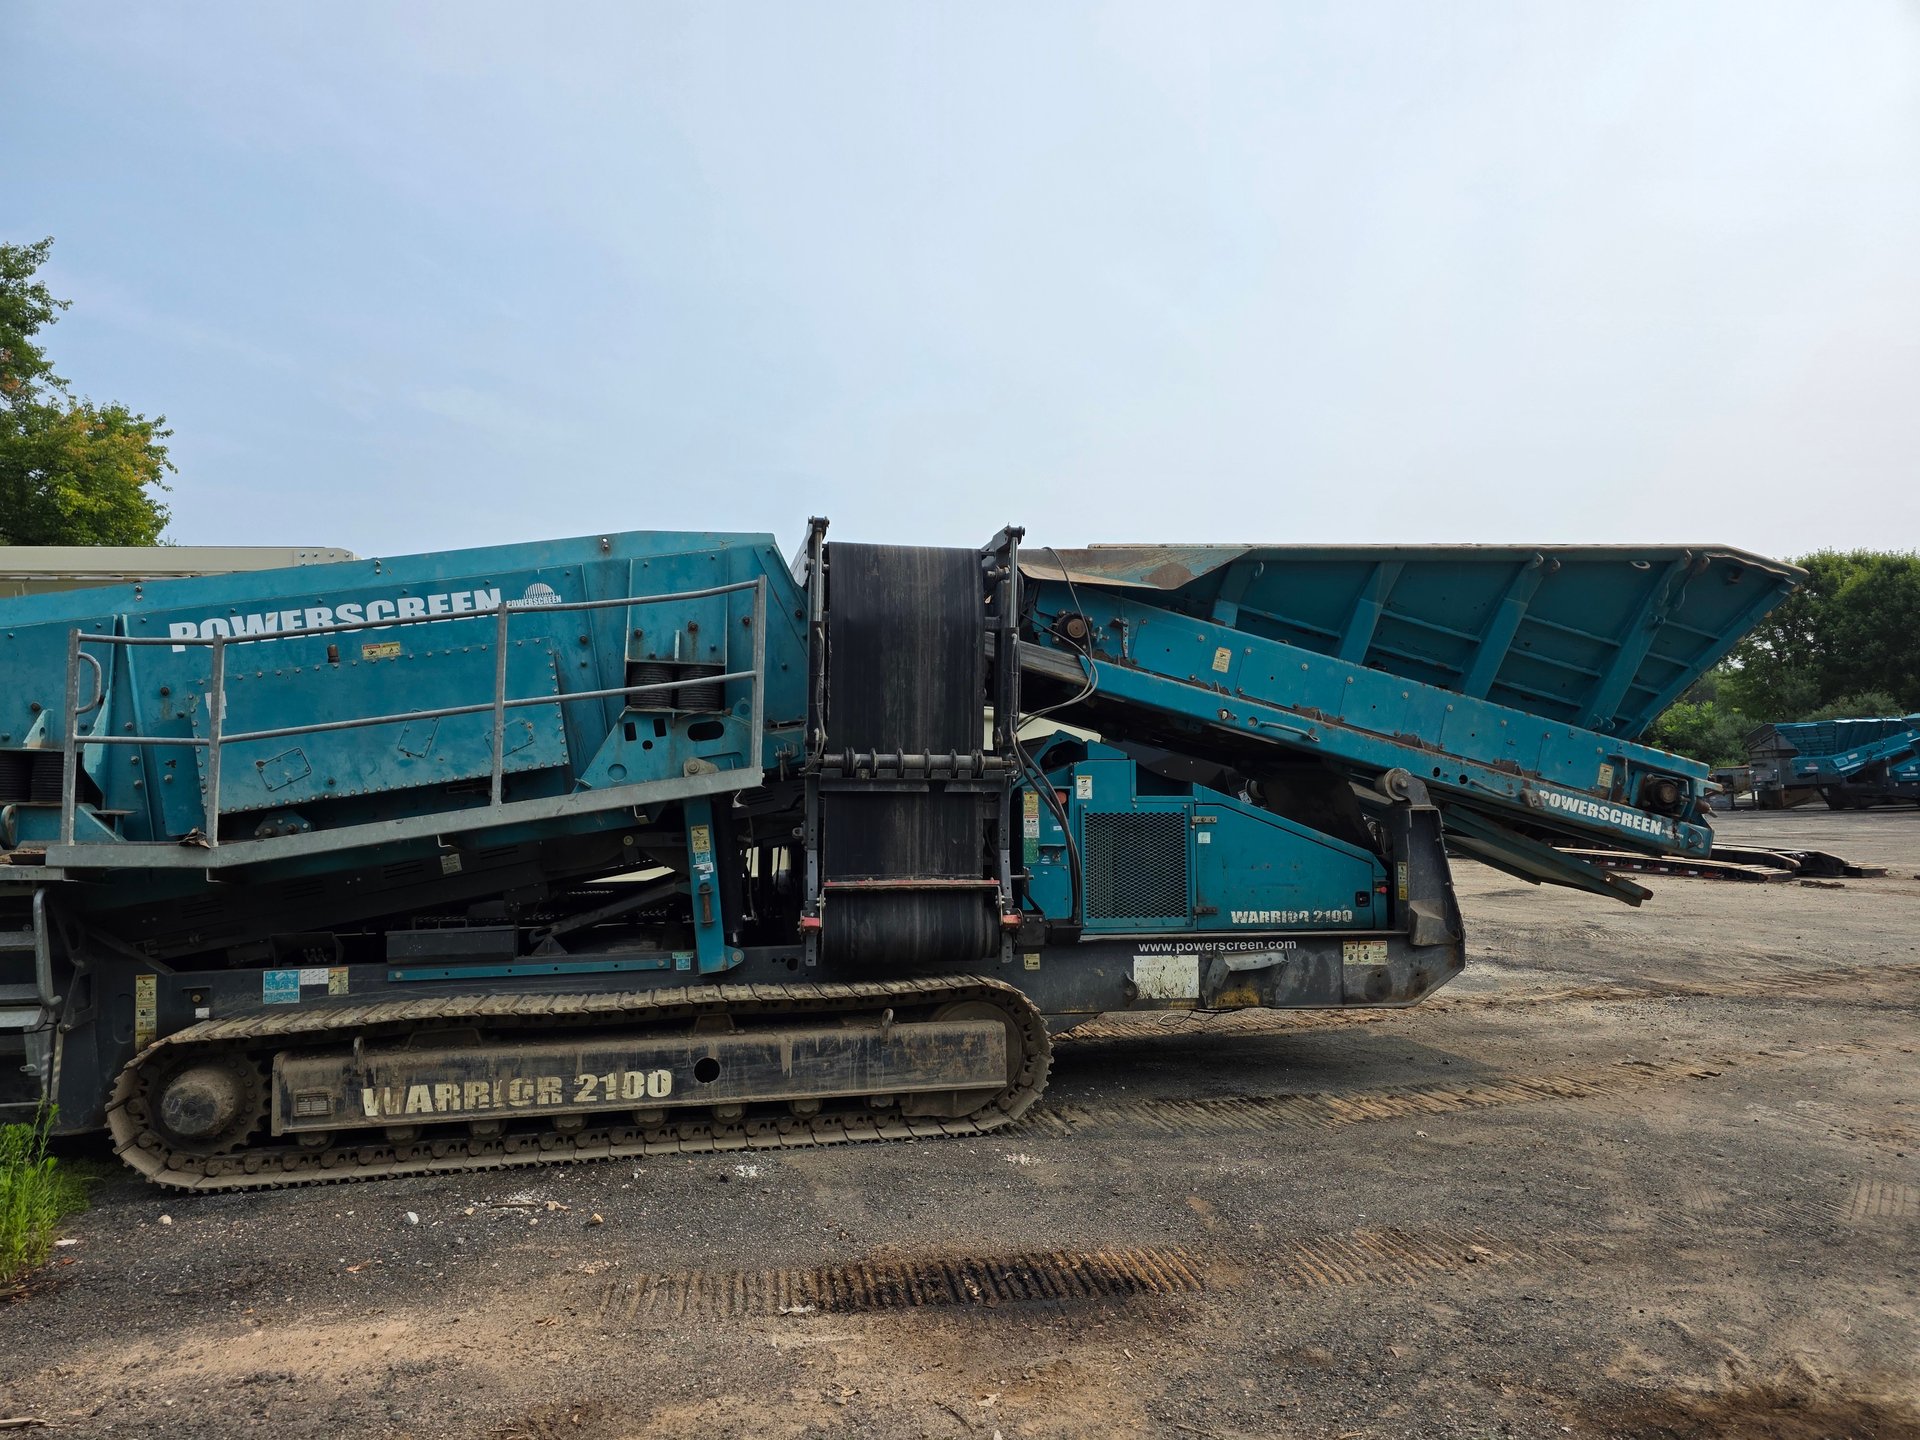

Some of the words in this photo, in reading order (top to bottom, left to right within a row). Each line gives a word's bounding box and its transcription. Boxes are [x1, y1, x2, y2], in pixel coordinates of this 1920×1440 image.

[506, 595, 562, 609] POWERSCREEN
[169, 588, 501, 653] POWERSCREEN
[1539, 790, 1662, 835] POWERSCREEN
[1231, 911, 1309, 924] WARRIOR
[1313, 910, 1353, 923] 2100
[1138, 940, 1297, 954] www.powerscreen.com
[574, 1069, 672, 1103] 2100
